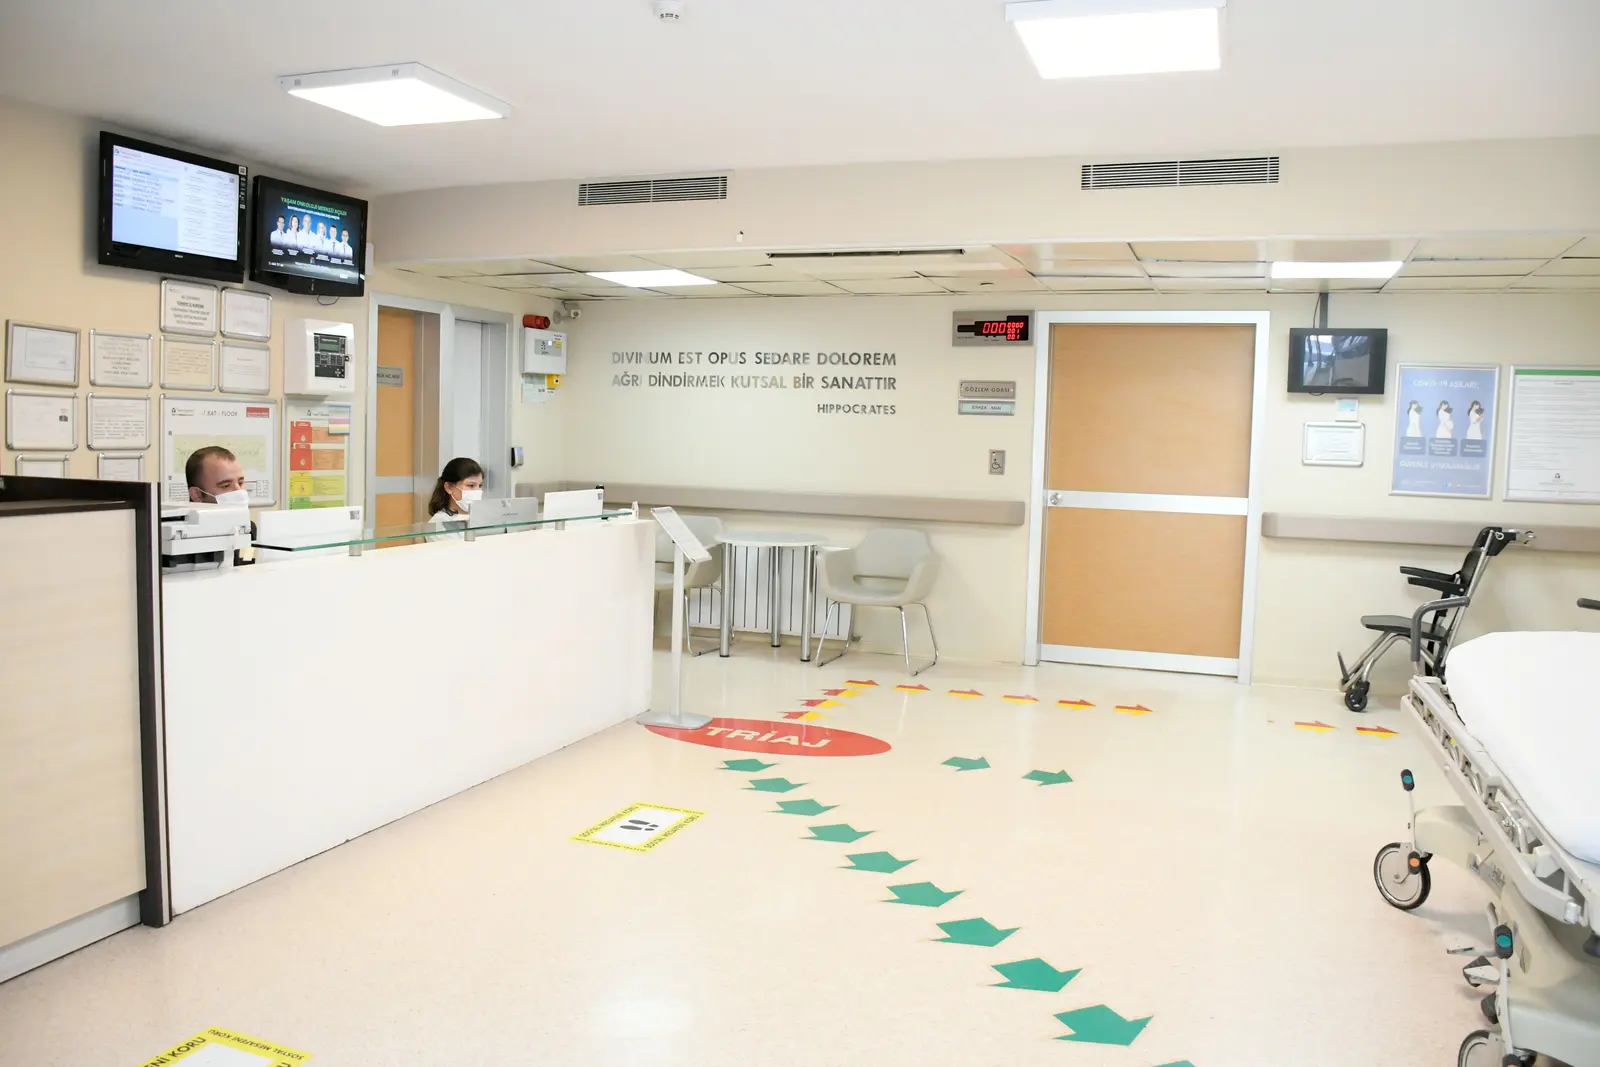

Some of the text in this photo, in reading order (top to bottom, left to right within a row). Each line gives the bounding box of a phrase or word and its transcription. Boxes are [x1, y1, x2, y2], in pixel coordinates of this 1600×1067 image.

[982, 322, 1006, 334] 000
[678, 351, 702, 365] EST
[708, 351, 747, 365] OPUS
[754, 351, 810, 365] SEDARE
[817, 352, 896, 366] DOLOREM
[612, 371, 896, 390] AĞRI DİNDİRMEK KUTSAL BİR SANATTIR
[817, 404, 896, 415] HIPPOCRATES
[706, 726, 832, 748] TRİAJ
[208, 1029, 233, 1039] KORU
[168, 1037, 206, 1058] KORU
[273, 1047, 305, 1060] SOSYAL
